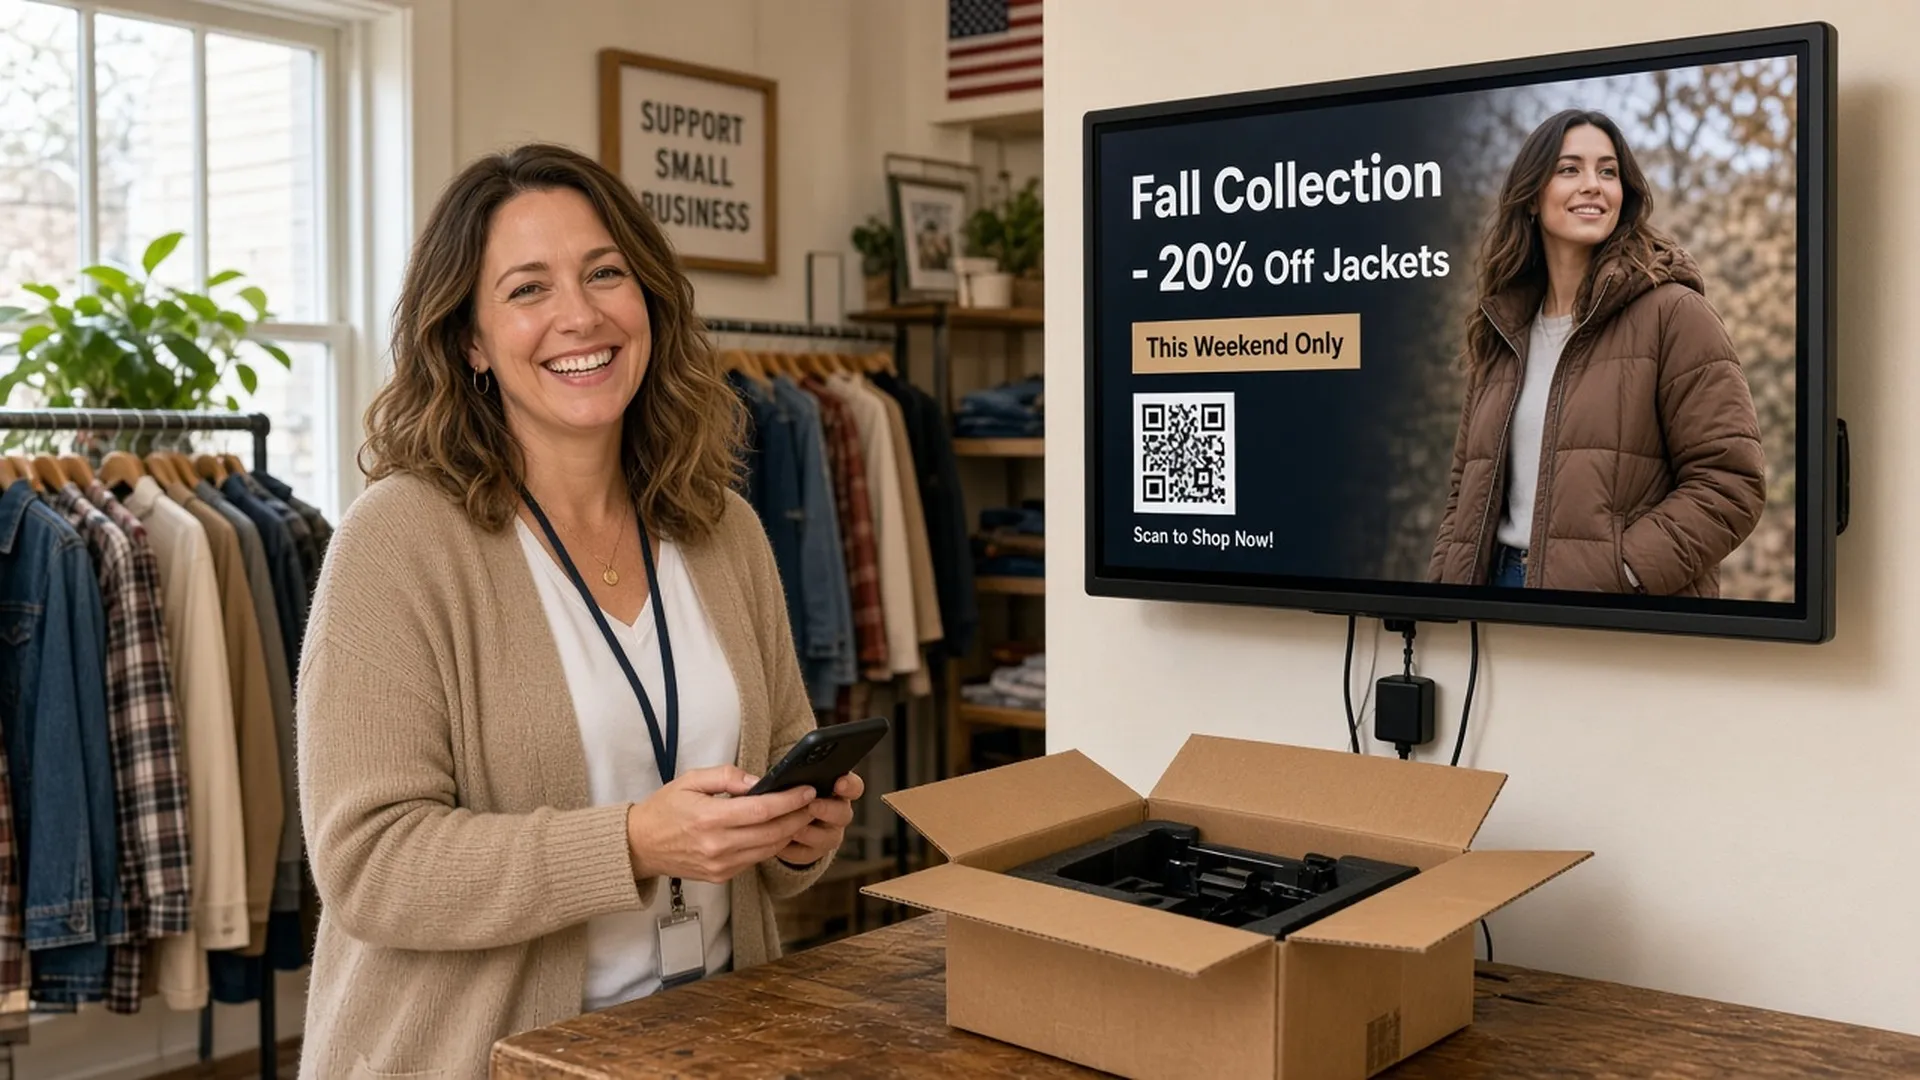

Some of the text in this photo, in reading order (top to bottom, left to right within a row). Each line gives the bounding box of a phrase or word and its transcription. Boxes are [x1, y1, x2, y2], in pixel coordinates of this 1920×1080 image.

[641, 100, 744, 145] SUPPORT
[656, 148, 733, 188] SMALL
[1132, 153, 1442, 220] Fall Collection
[641, 191, 750, 232] BUSINESS
[1159, 241, 1254, 291] 20%
[1264, 248, 1315, 285] Off
[1323, 244, 1450, 283] Jackets
[1146, 331, 1344, 360] This Weekend Only
[1133, 526, 1274, 551] Scan to Shop Now!
